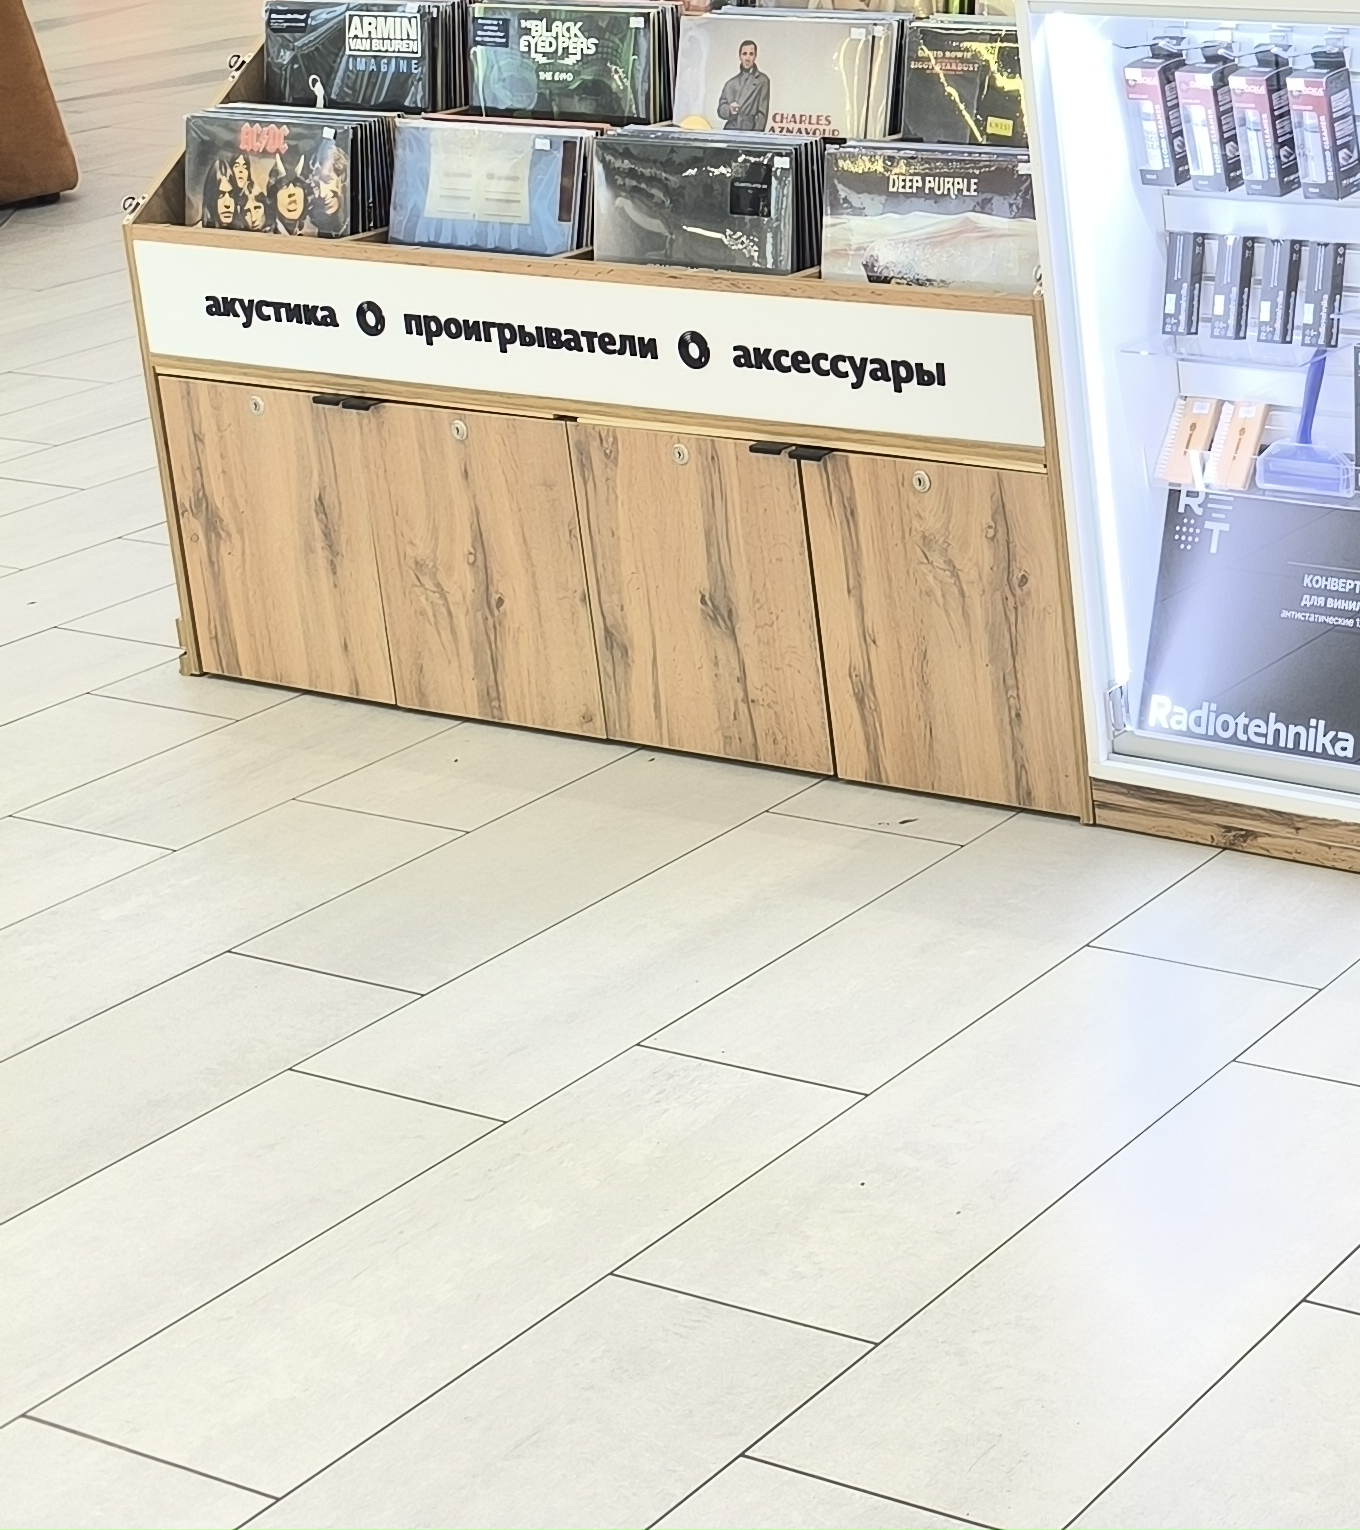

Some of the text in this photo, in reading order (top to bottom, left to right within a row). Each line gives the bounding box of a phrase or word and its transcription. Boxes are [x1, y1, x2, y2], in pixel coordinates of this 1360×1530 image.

[348, 16, 418, 40] ARMIN
[530, 19, 584, 39] BLACK
[348, 39, 418, 53] VAN BUUREN
[520, 35, 558, 57] EYED
[348, 58, 420, 73] IMAGINE
[772, 113, 832, 126] CHARLES
[888, 174, 978, 199] DEEP PURPLE
[204, 290, 947, 393] акустика проигрыватели аксессуары
[1301, 594, 1324, 608] для
[1280, 610, 1354, 628] антистатические
[1149, 694, 1355, 758] Radiotehnika
